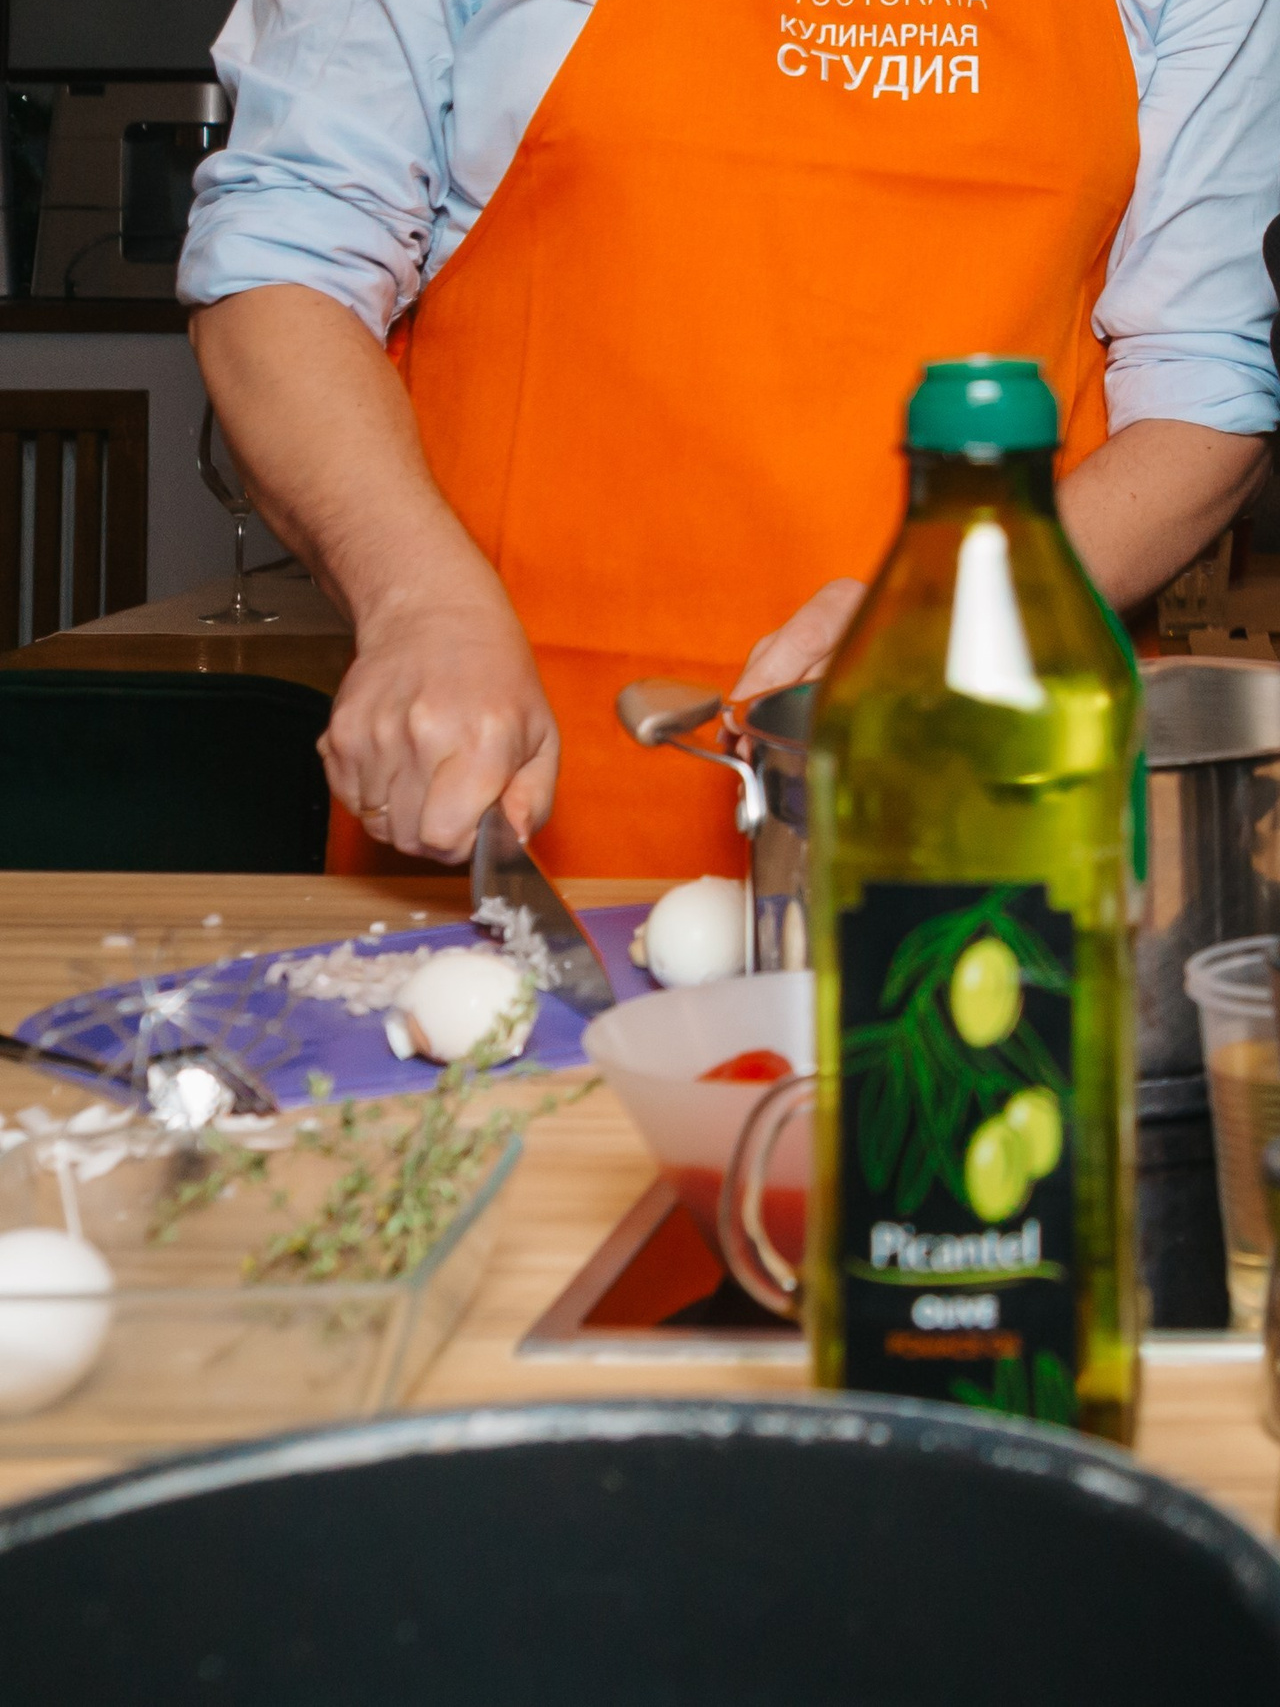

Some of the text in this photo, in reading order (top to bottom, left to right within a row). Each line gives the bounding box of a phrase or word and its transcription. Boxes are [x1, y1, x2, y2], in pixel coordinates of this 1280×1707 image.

[780, 13, 978, 48] КУЛИНАРНАЯ
[776, 42, 980, 101] СТУДИЯ
[870, 1217, 1042, 1273] Picantel
